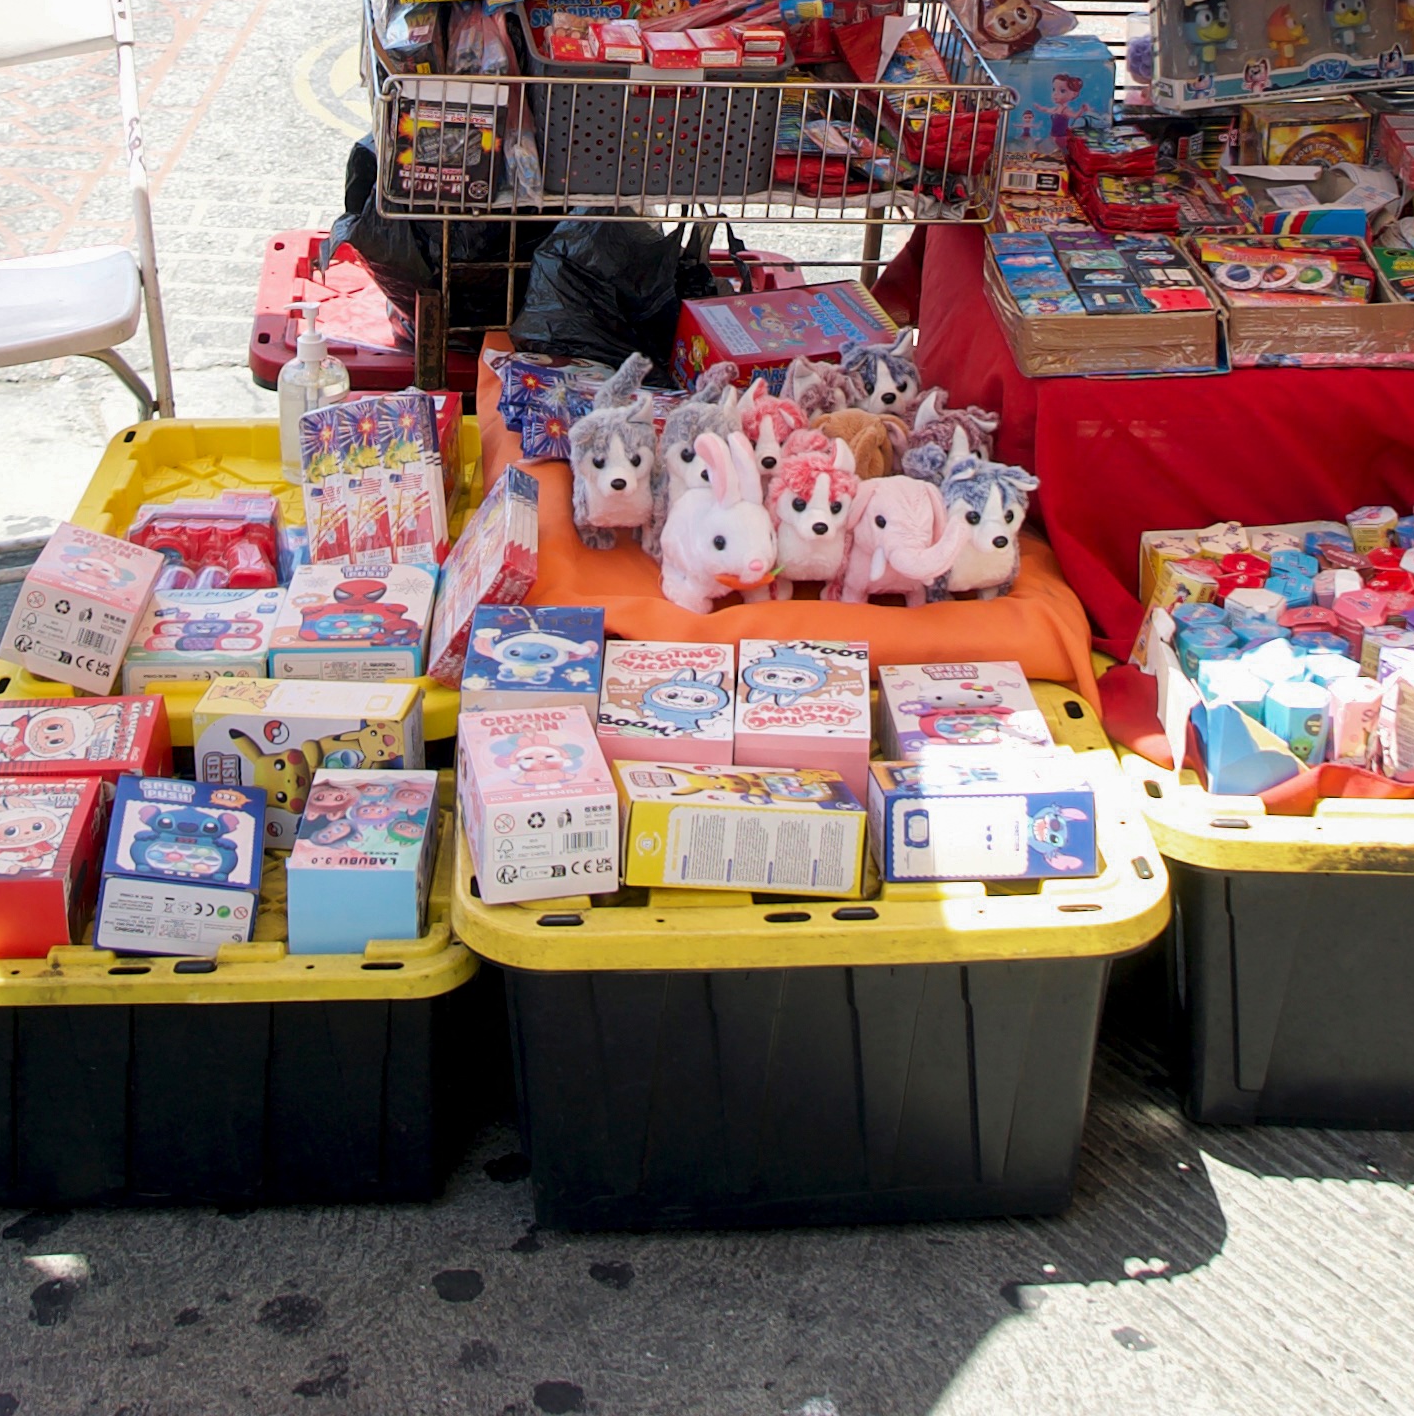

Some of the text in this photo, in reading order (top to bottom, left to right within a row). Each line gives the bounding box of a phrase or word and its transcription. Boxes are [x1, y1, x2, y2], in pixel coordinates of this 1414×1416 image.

[752, 368, 786, 384] PART
[628, 646, 722, 663] EXCITING
[617, 657, 713, 671] MACARON
[922, 664, 978, 675] SPEED
[480, 711, 567, 727] CRYING
[598, 713, 685, 737] BOOM!
[489, 721, 559, 737] AGAIN
[221, 755, 239, 785] USH
[139, 779, 196, 795] SPEED
[144, 789, 194, 803] PUSH
[339, 856, 397, 866] LABUBU
